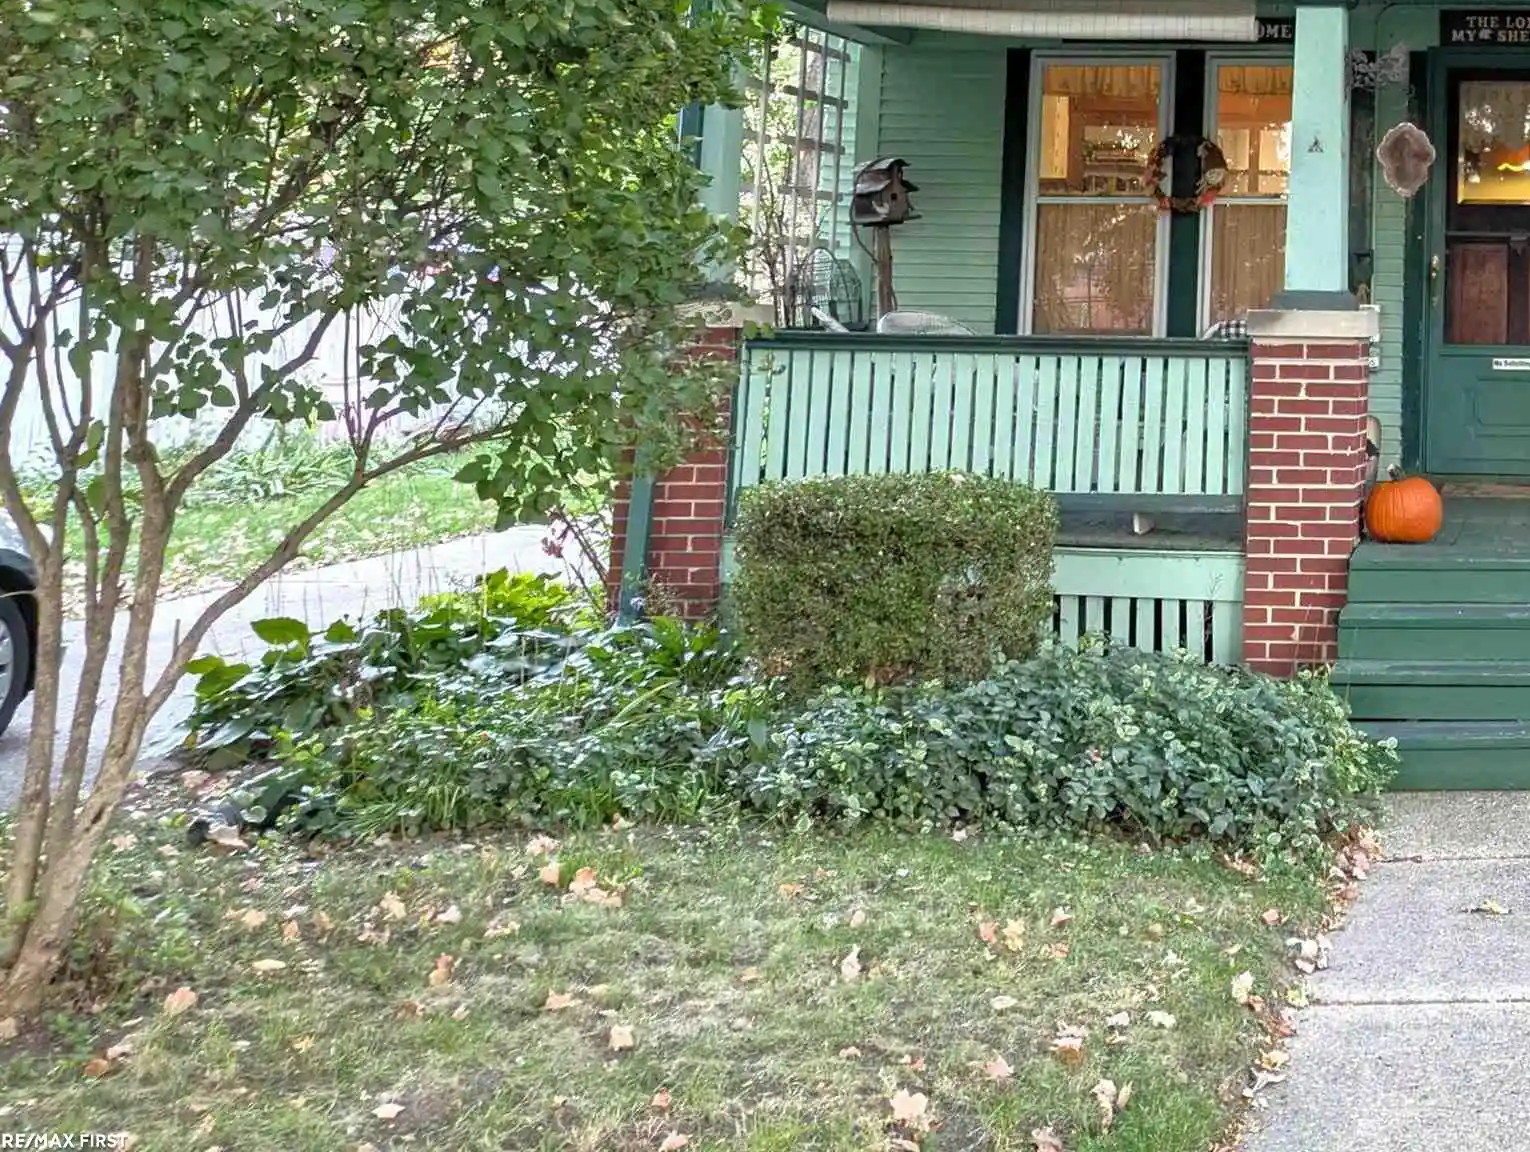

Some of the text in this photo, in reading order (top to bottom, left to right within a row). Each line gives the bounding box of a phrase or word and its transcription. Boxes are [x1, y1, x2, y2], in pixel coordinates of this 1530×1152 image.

[1465, 16, 1499, 28] THE
[1255, 22, 1292, 38] OME
[1451, 29, 1477, 42] MY
